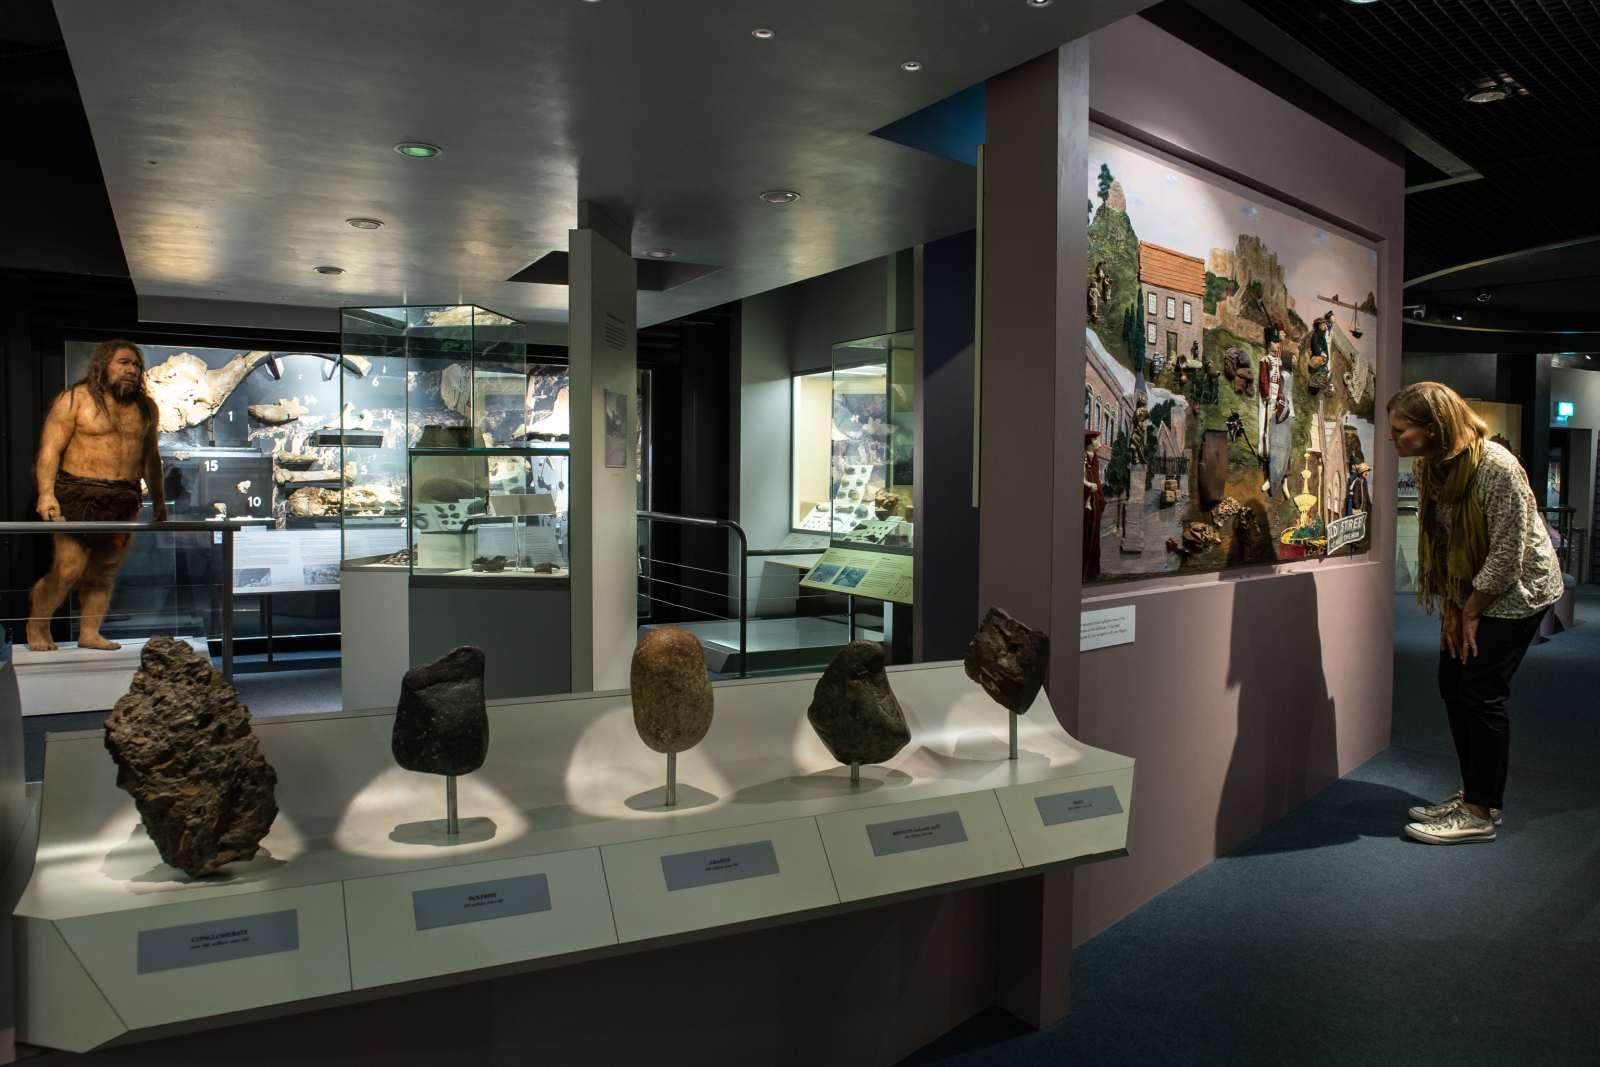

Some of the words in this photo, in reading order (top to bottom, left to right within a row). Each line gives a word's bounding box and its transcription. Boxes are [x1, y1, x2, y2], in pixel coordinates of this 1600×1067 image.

[372, 376, 379, 387] 6
[228, 410, 233, 422] 1
[204, 460, 219, 472] 15
[361, 464, 368, 475] 5
[247, 496, 262, 508] 10
[400, 517, 407, 528] 2
